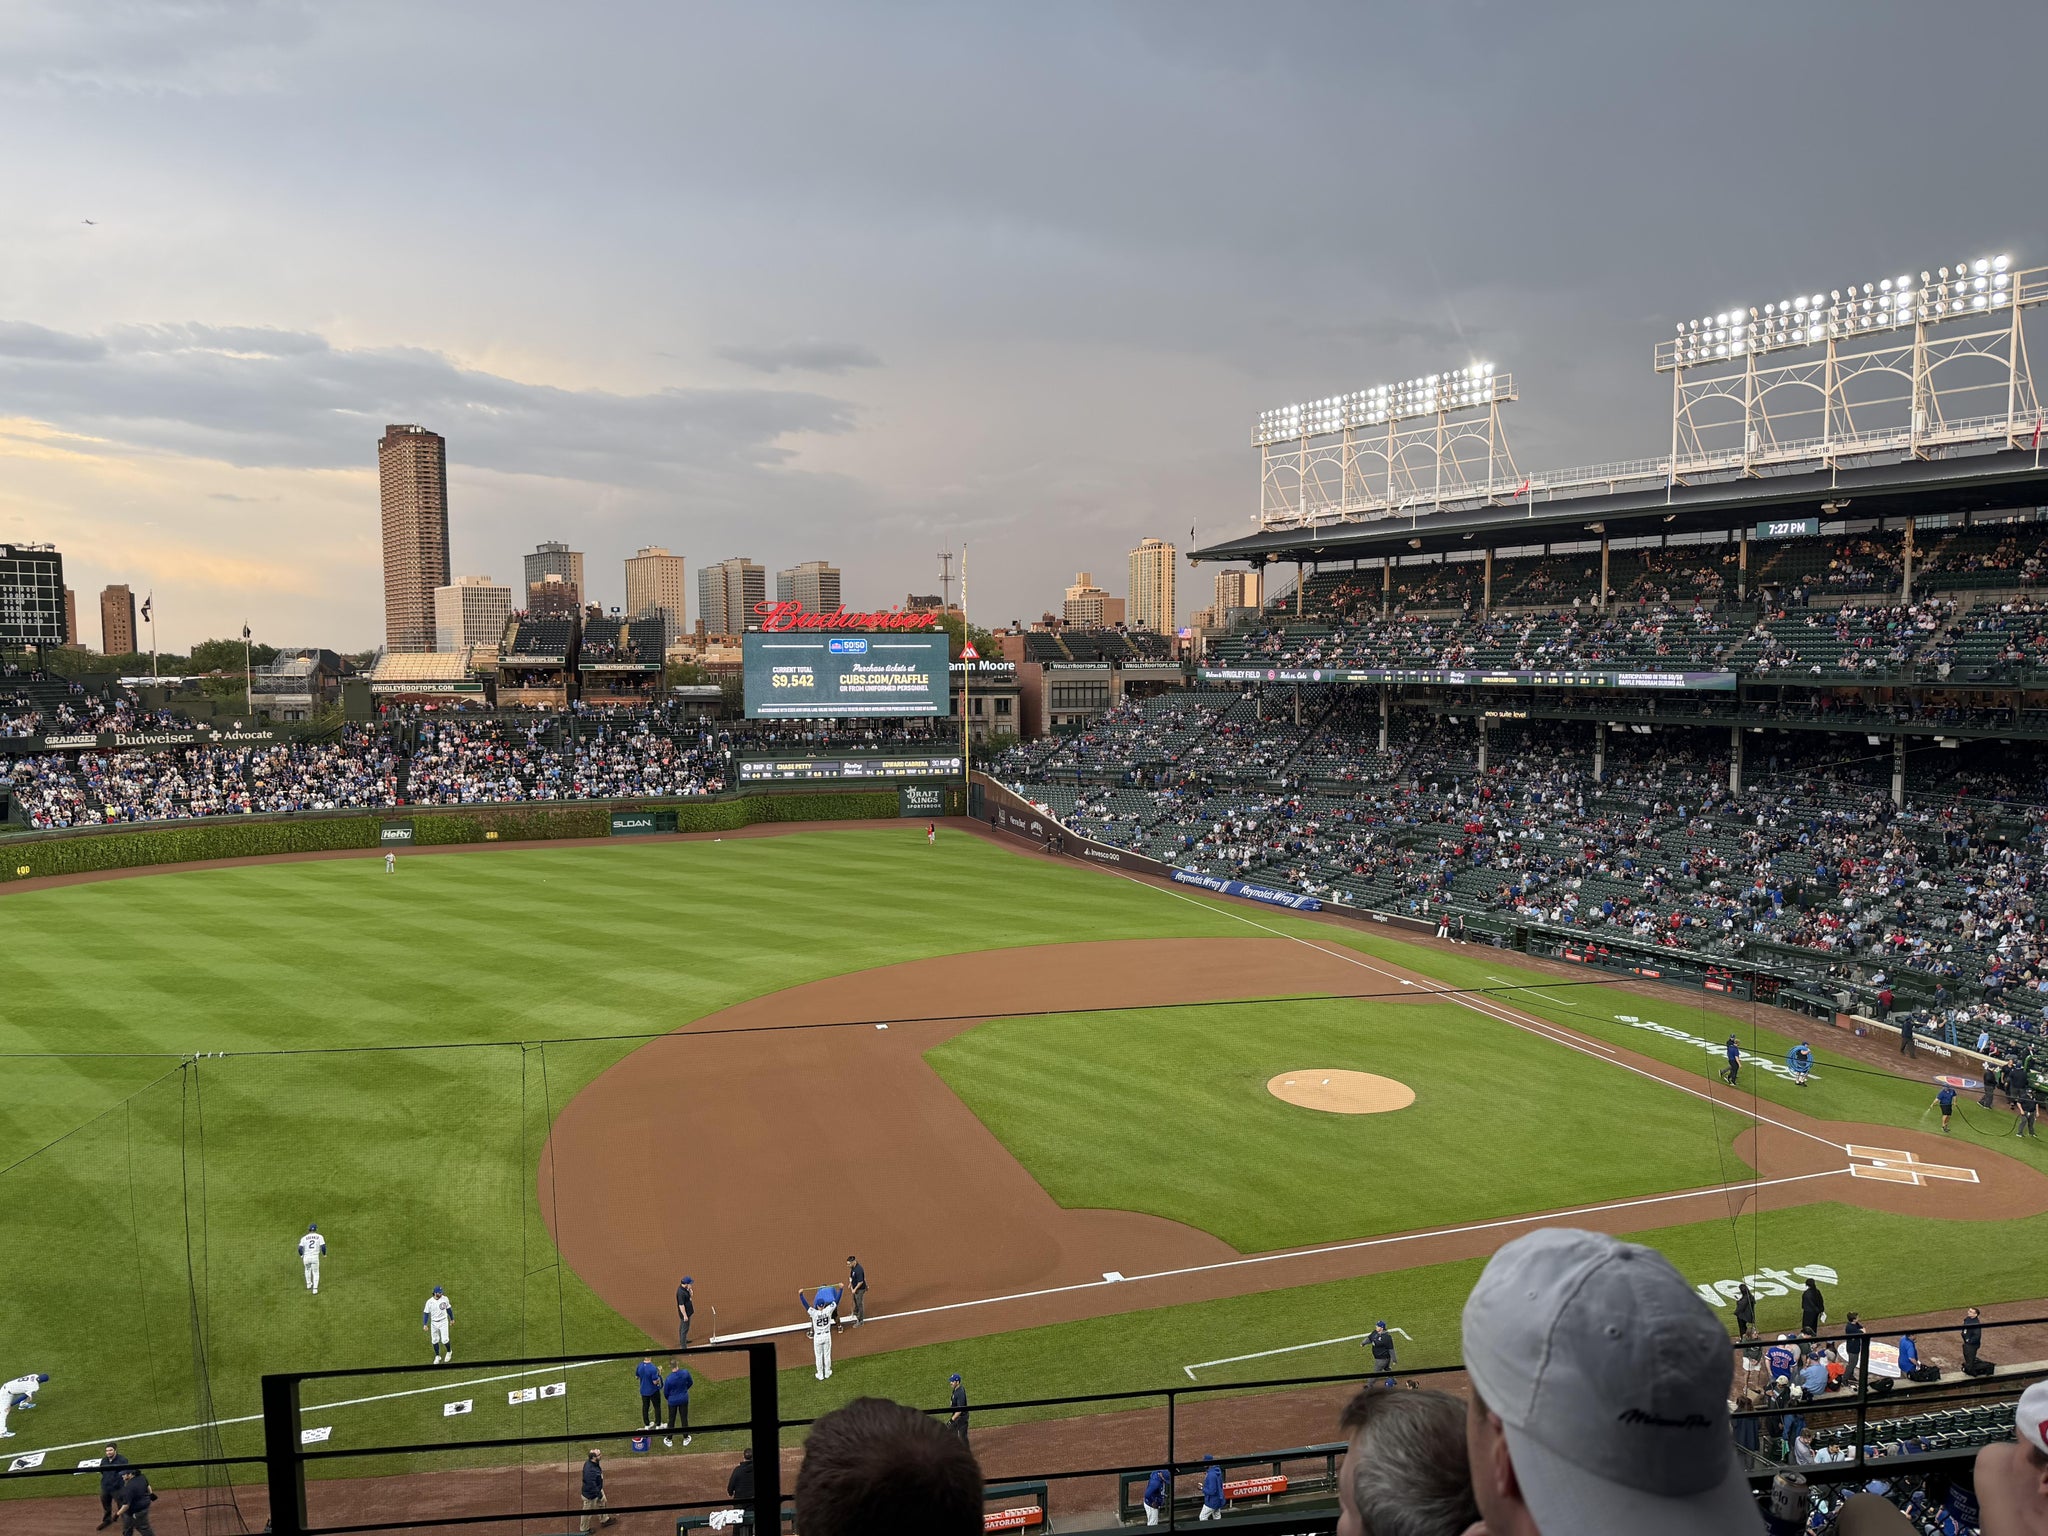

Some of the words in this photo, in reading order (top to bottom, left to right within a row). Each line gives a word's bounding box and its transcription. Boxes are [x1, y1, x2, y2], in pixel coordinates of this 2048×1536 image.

[1769, 523, 1789, 534] 7:27
[1790, 522, 1806, 533] PM
[754, 600, 938, 632] Budweiser
[853, 663, 885, 672] Purchase
[886, 663, 907, 672] tickets
[979, 660, 1015, 670] Moore
[772, 674, 814, 688] $9,542
[839, 674, 929, 685] CUBS.COM/RAFFLE
[44, 735, 97, 744] GRAINGER
[224, 731, 273, 740] Advocate
[384, 830, 410, 838] Hefty
[1091, 848, 1109, 859] Invesco
[17, 865, 30, 875] 400
[1175, 872, 1203, 885] Reynolds
[1203, 877, 1221, 891] Wrap
[1240, 886, 1274, 899] Reynolds
[1273, 892, 1294, 905] Wrap
[1913, 1039, 1951, 1057] TimberTech
[309, 1240, 315, 1249] 2
[816, 1317, 829, 1327] 29
[1772, 1357, 1789, 1369] 23
[1233, 1484, 1273, 1496] GATORADE
[984, 1517, 1026, 1529] GATORADE
